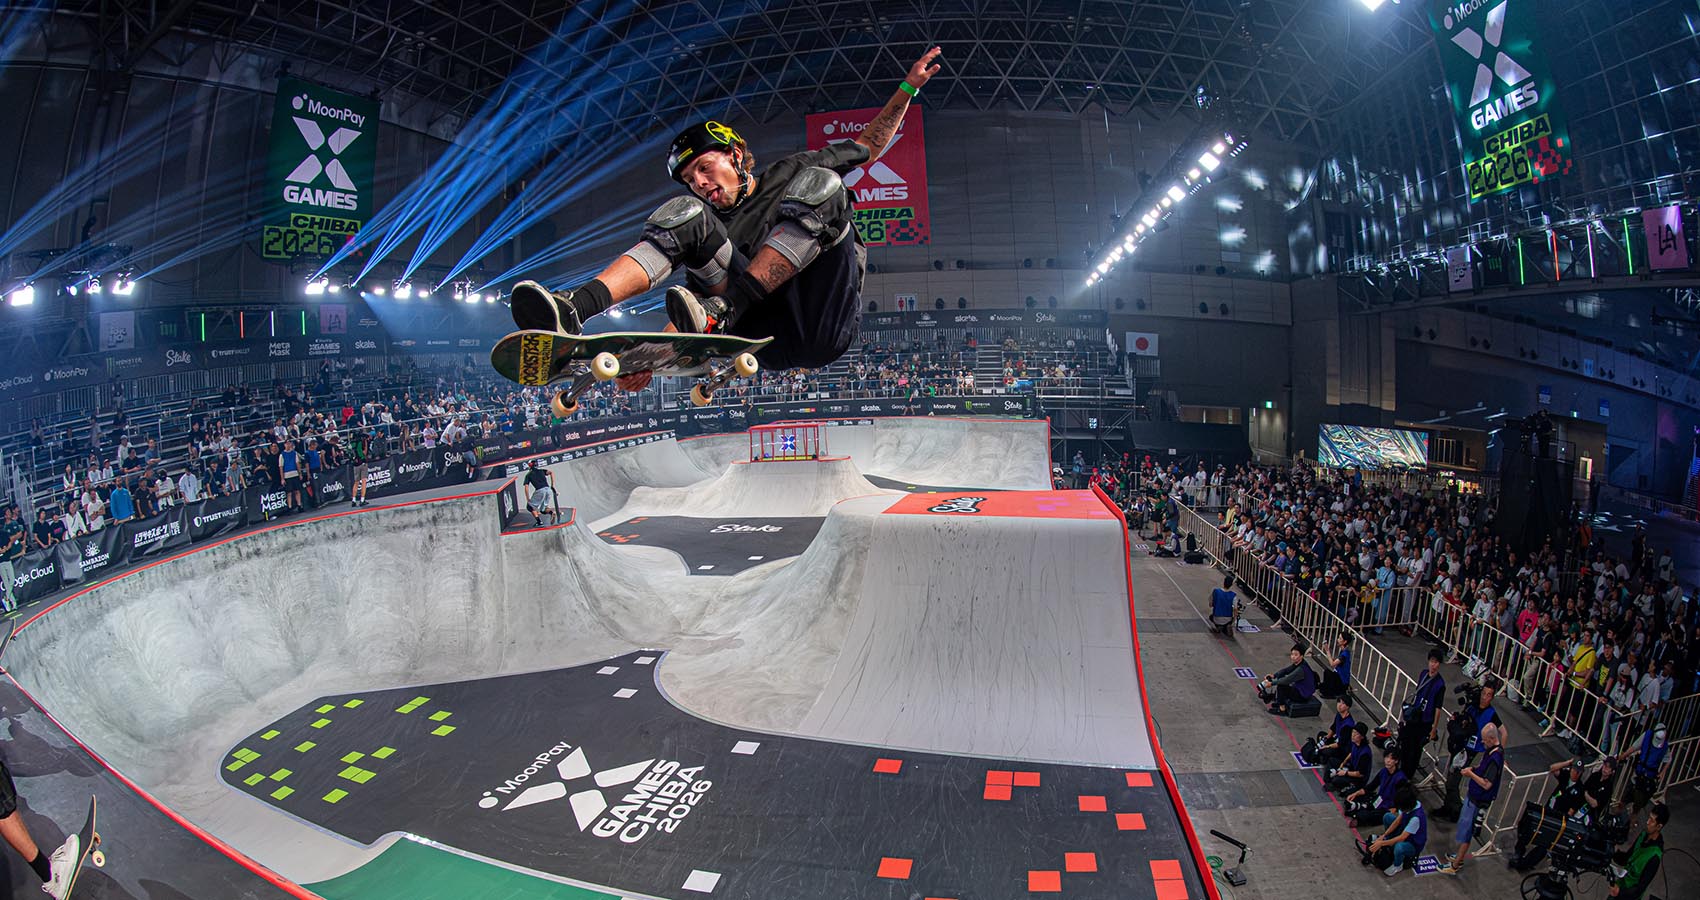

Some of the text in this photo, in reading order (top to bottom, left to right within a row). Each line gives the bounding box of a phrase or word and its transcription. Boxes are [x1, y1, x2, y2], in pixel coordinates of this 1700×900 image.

[308, 99, 365, 127] MoonPay
[1471, 82, 1539, 130] GAMES
[1486, 119, 1549, 154] CHIBA
[1469, 147, 1531, 195] 2026
[283, 185, 358, 210] GAMES
[853, 208, 914, 220] HIBA
[293, 215, 360, 233] CHIBA
[858, 221, 884, 242] 26
[265, 228, 334, 256] 2026
[269, 342, 290, 350] Meta
[269, 349, 290, 357] Mask
[166, 350, 191, 367] Stake
[53, 367, 89, 380] MoonPay
[1004, 401, 1023, 411] Stake
[406, 461, 432, 473] MoonPay
[261, 491, 287, 504] Meta
[262, 498, 287, 513] Mask
[710, 523, 783, 533] Stake
[30, 563, 54, 580] Cloud
[495, 741, 572, 793] MoonPay
[591, 759, 681, 837] GAMES
[619, 765, 704, 843] CHIBA
[656, 779, 713, 833] 2026
